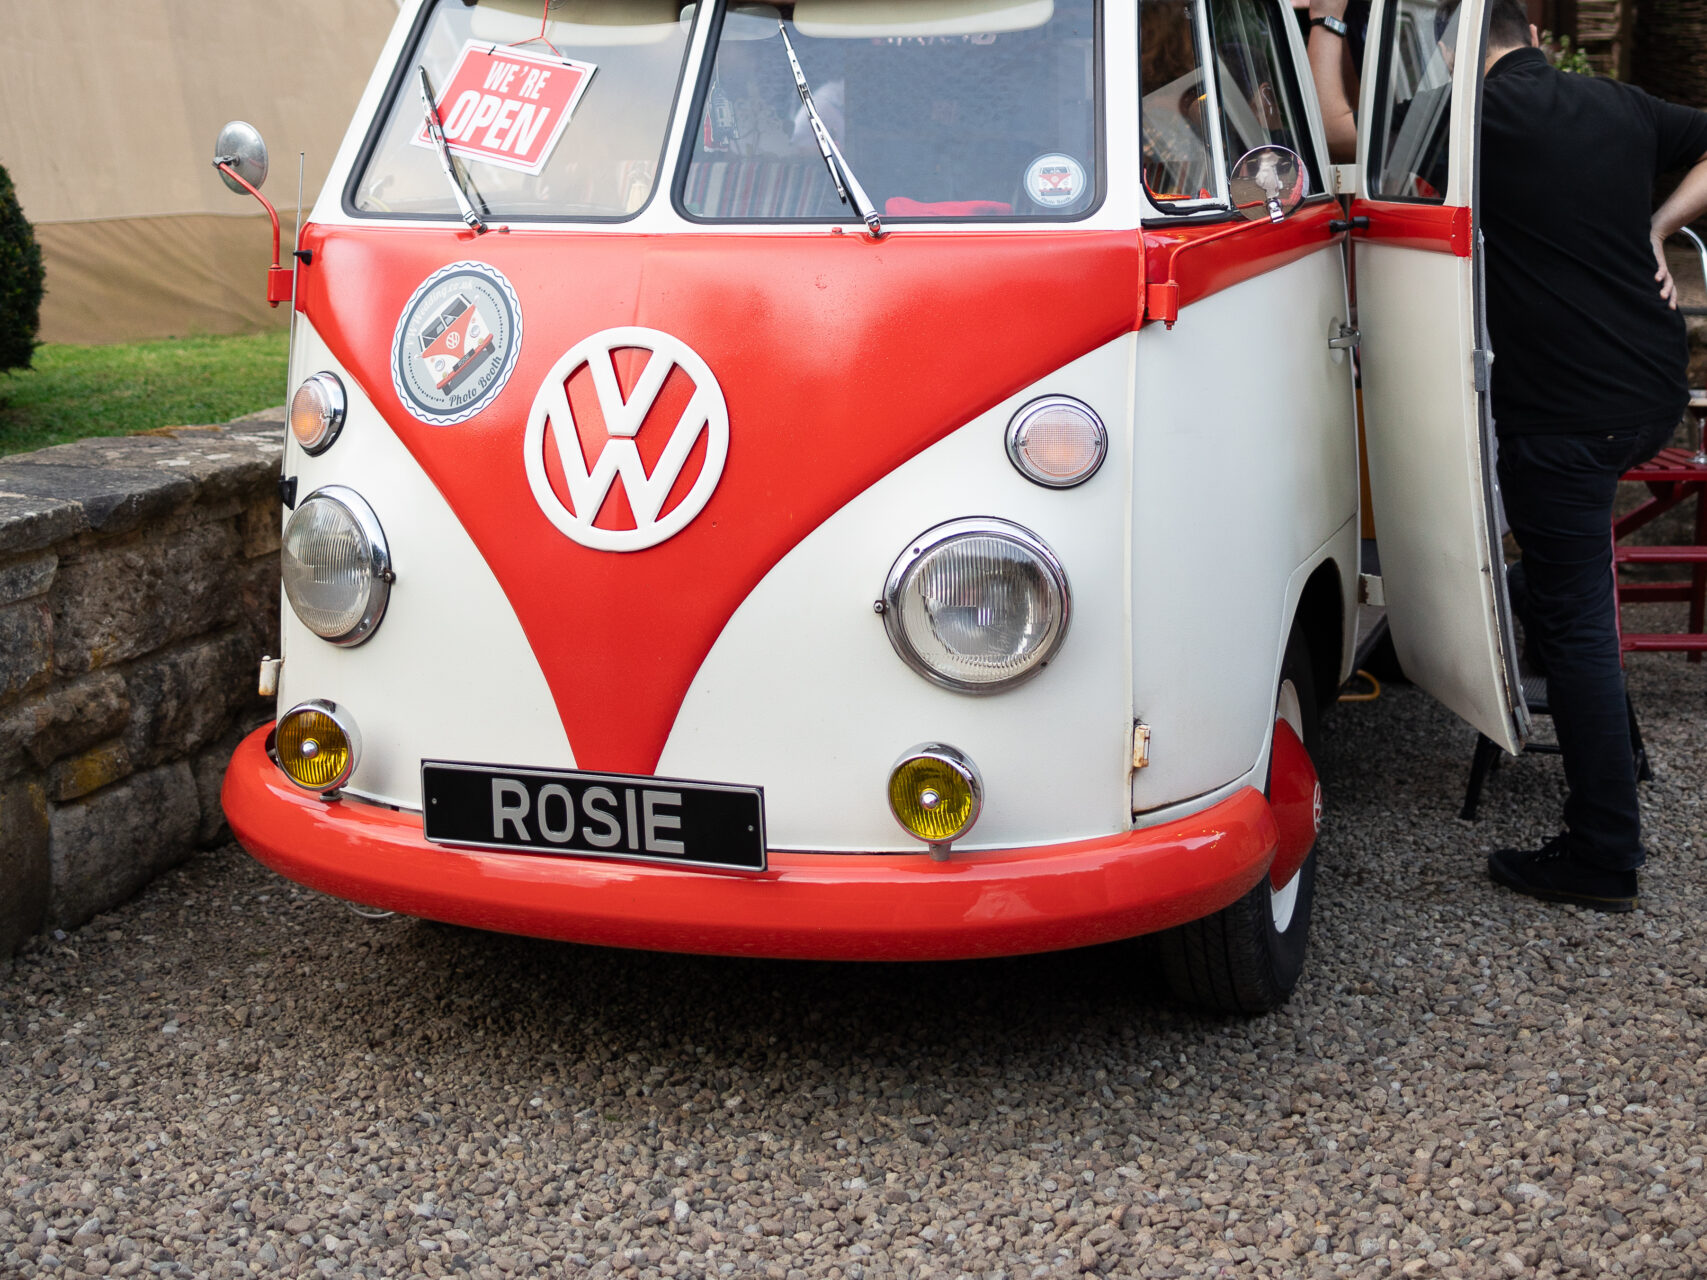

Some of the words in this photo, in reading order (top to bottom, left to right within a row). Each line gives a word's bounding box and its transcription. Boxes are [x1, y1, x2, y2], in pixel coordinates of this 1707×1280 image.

[483, 61, 551, 100] WE'RE
[444, 90, 551, 156] OPEN
[449, 387, 477, 407] Photo
[478, 356, 502, 389] Booth
[536, 338, 716, 538] VW
[491, 777, 685, 854] ROSIE
